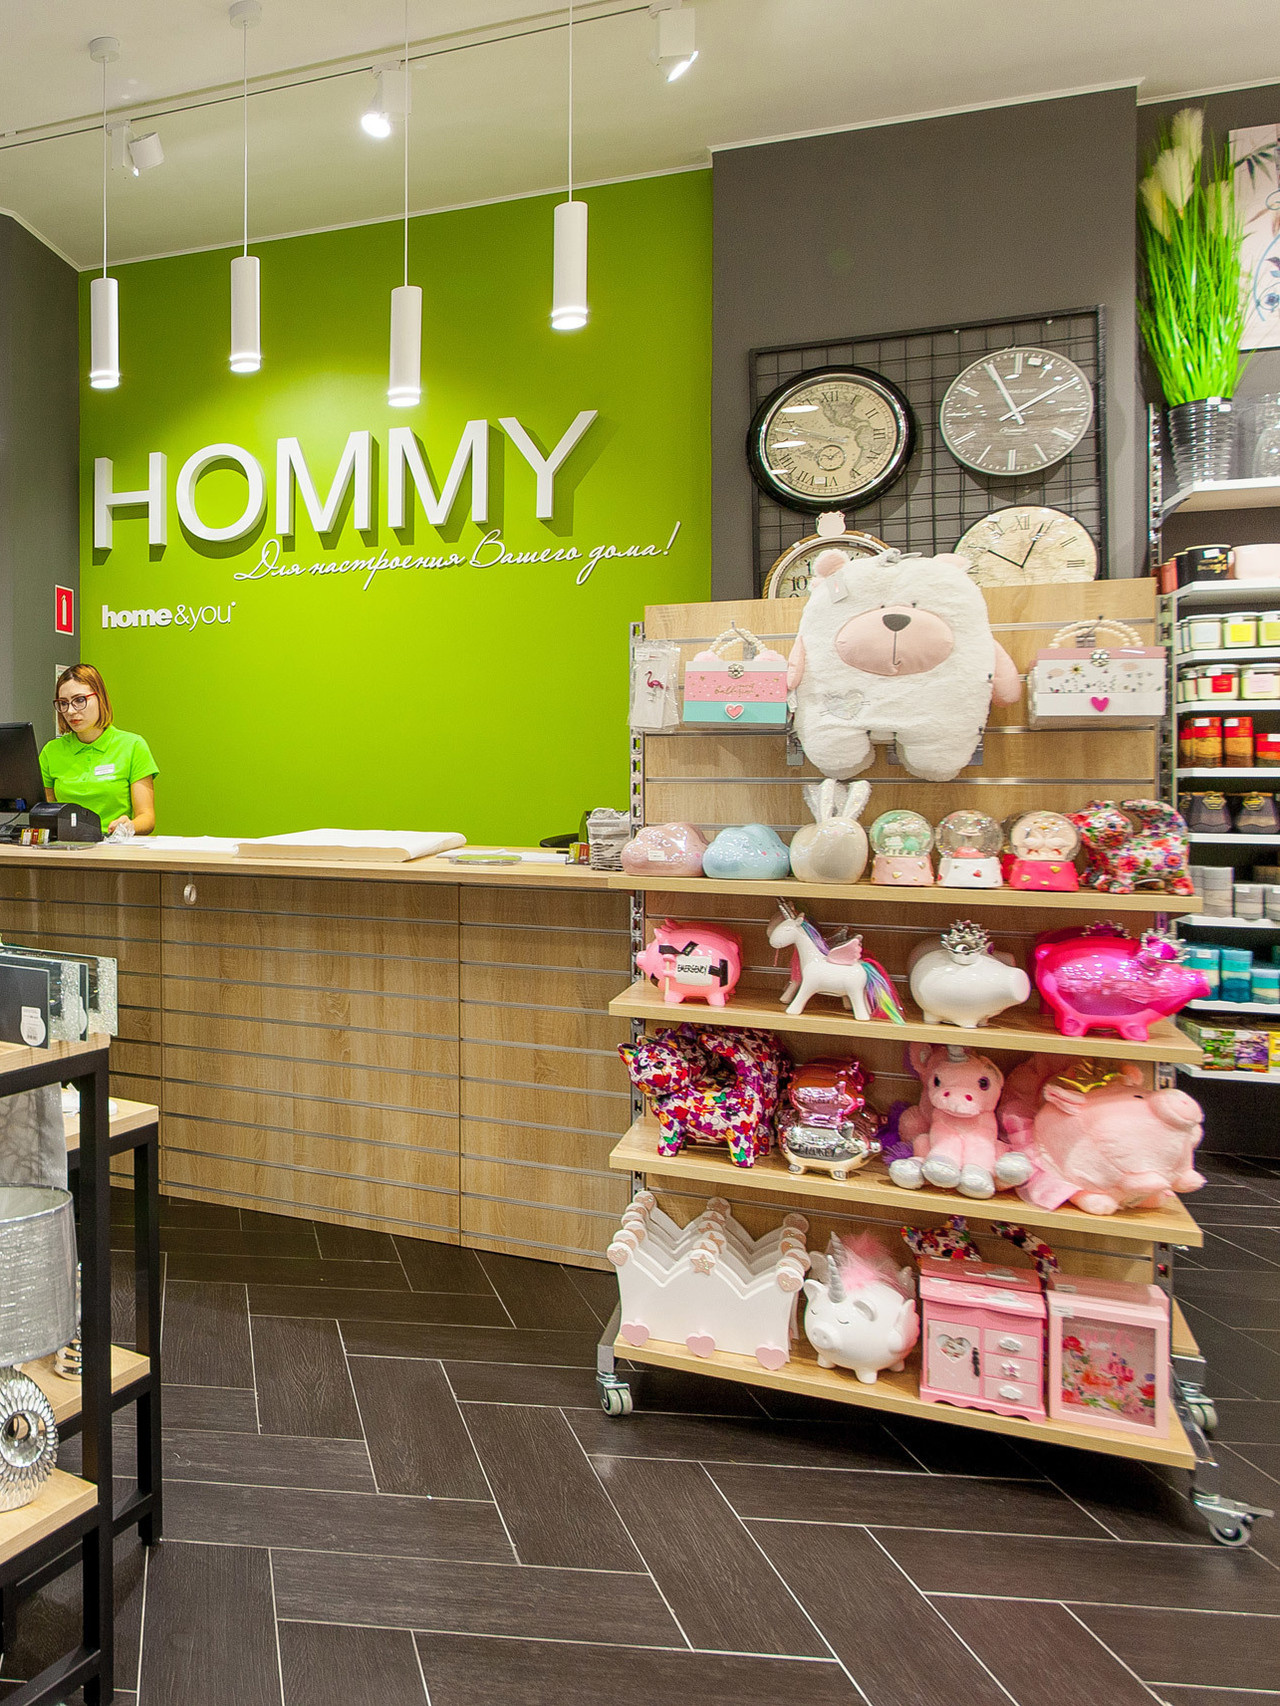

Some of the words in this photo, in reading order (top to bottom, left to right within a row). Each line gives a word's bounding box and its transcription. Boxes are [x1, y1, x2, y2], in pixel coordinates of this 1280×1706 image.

[93, 410, 598, 550] HOMMY
[234, 538, 304, 580] Для
[308, 547, 466, 591] настроения
[468, 529, 583, 568] Вашего
[575, 521, 682, 585] дома!
[677, 963, 708, 976] EMERGENCY
